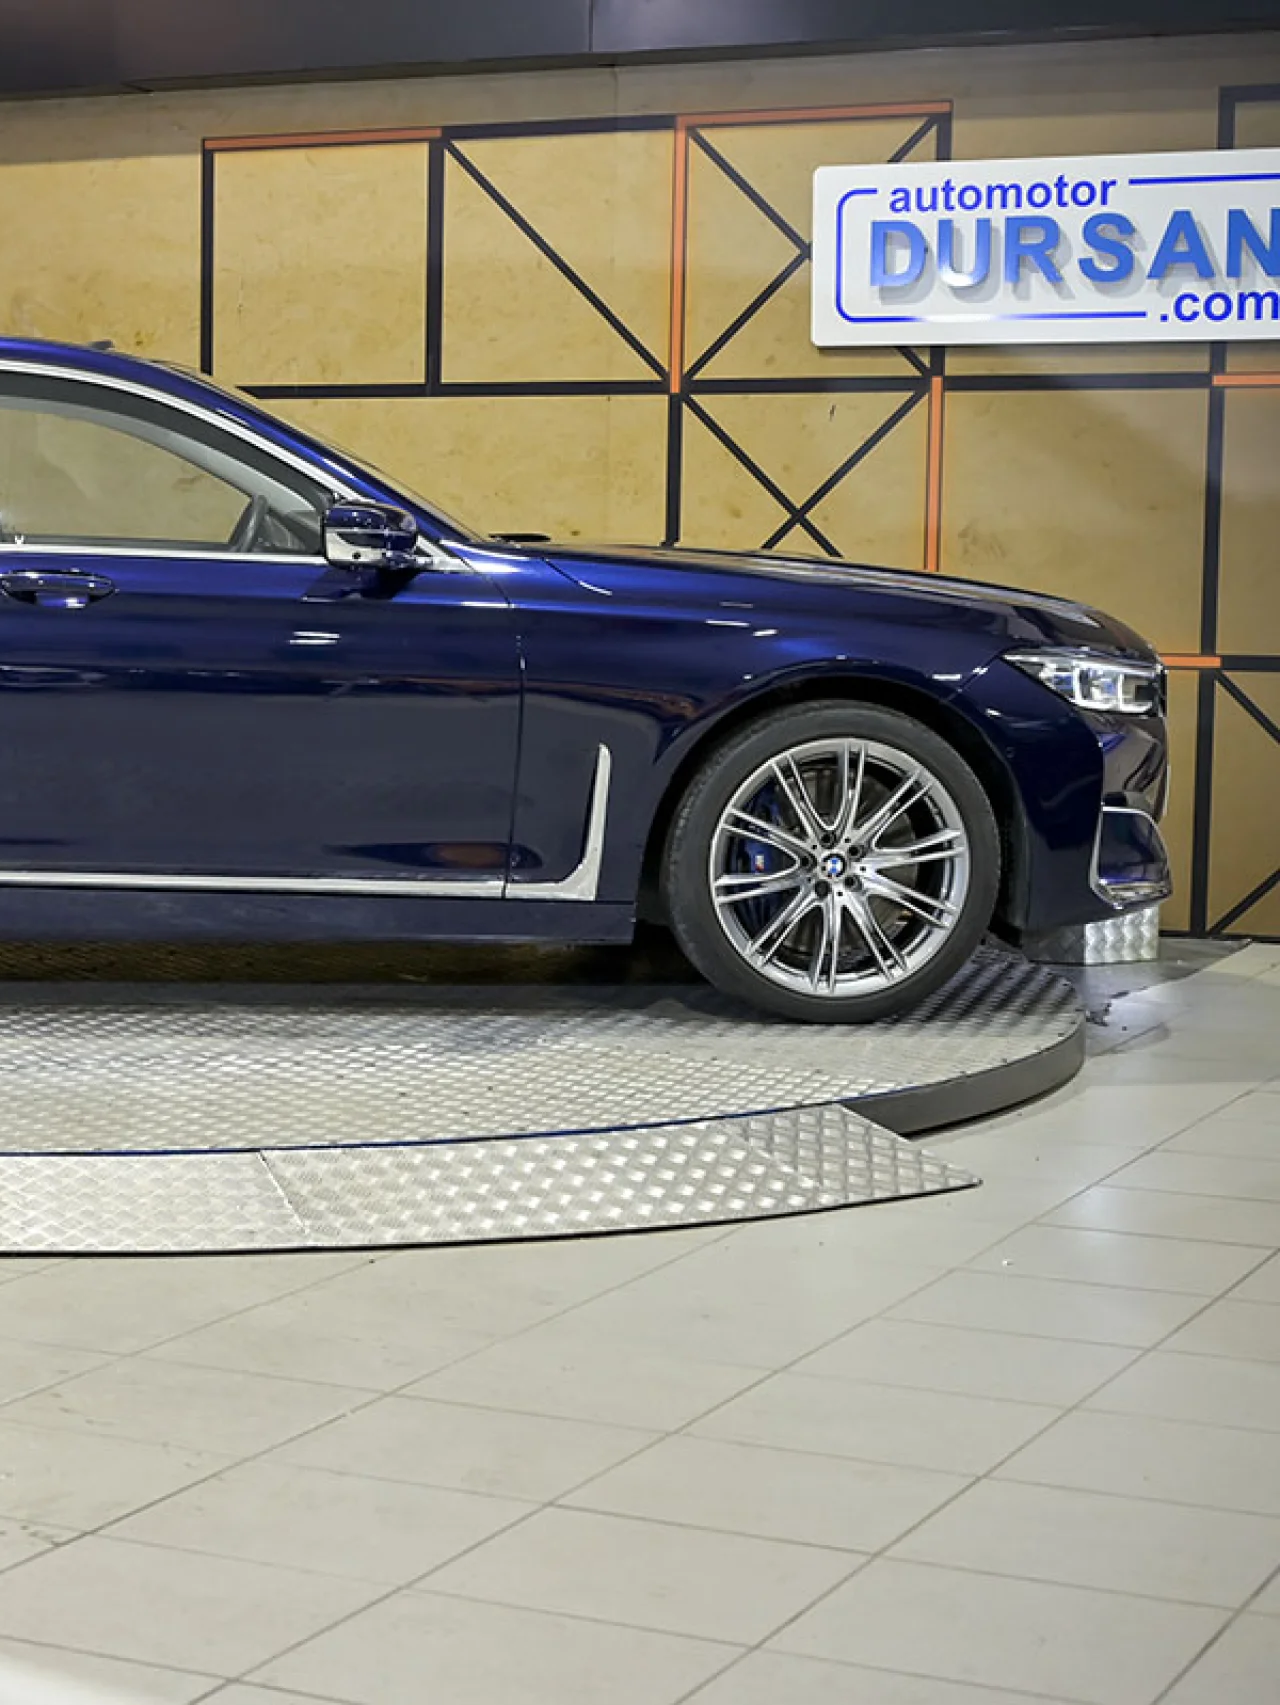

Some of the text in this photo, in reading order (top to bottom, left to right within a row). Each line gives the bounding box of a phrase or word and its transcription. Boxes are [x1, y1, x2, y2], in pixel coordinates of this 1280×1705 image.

[889, 174, 1117, 213] automotor
[869, 208, 1280, 288] DURSAN
[1160, 290, 1280, 323] .com
